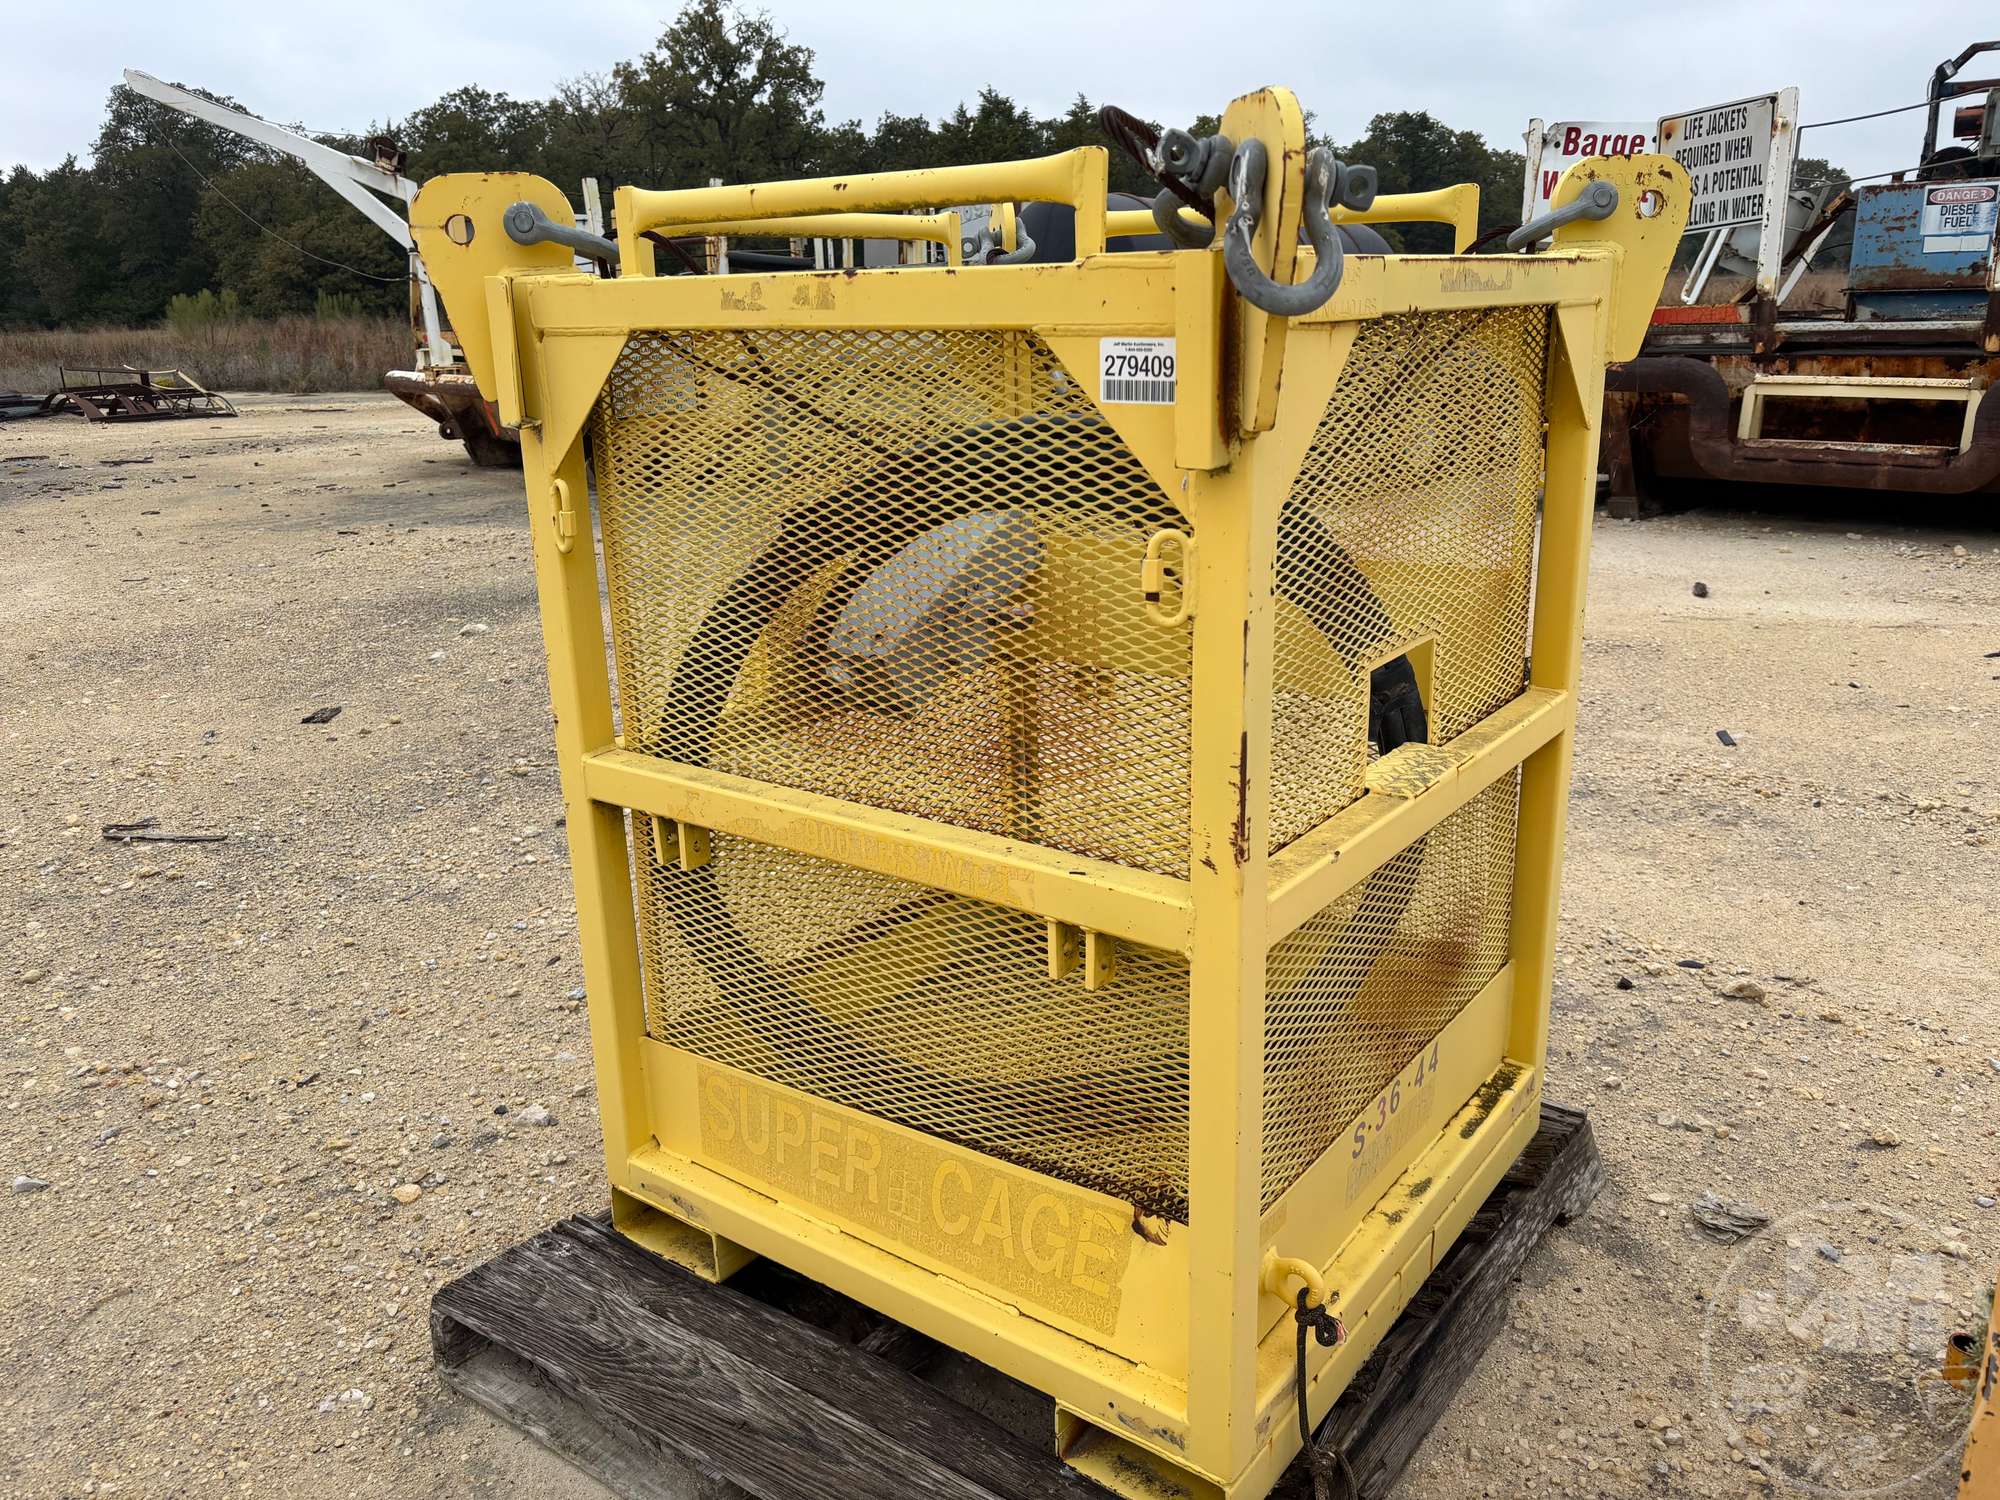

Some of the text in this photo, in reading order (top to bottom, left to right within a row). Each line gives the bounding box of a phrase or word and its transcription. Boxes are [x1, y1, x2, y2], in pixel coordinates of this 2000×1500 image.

[1683, 106, 1748, 141] LIFE JACKETS
[1562, 126, 1646, 157] Barge
[1724, 135, 1753, 162] WHEN
[1702, 173, 1709, 196] A
[1711, 163, 1763, 194] POTENTIAL
[1718, 198, 1729, 223] IN
[1732, 193, 1764, 220] WATER
[1940, 203, 1980, 217] DIESEL
[1943, 216, 1972, 228] FUEL
[1104, 354, 1175, 378] 279409
[703, 1074, 883, 1204] SUPER
[931, 1158, 1128, 1298] CAGE
